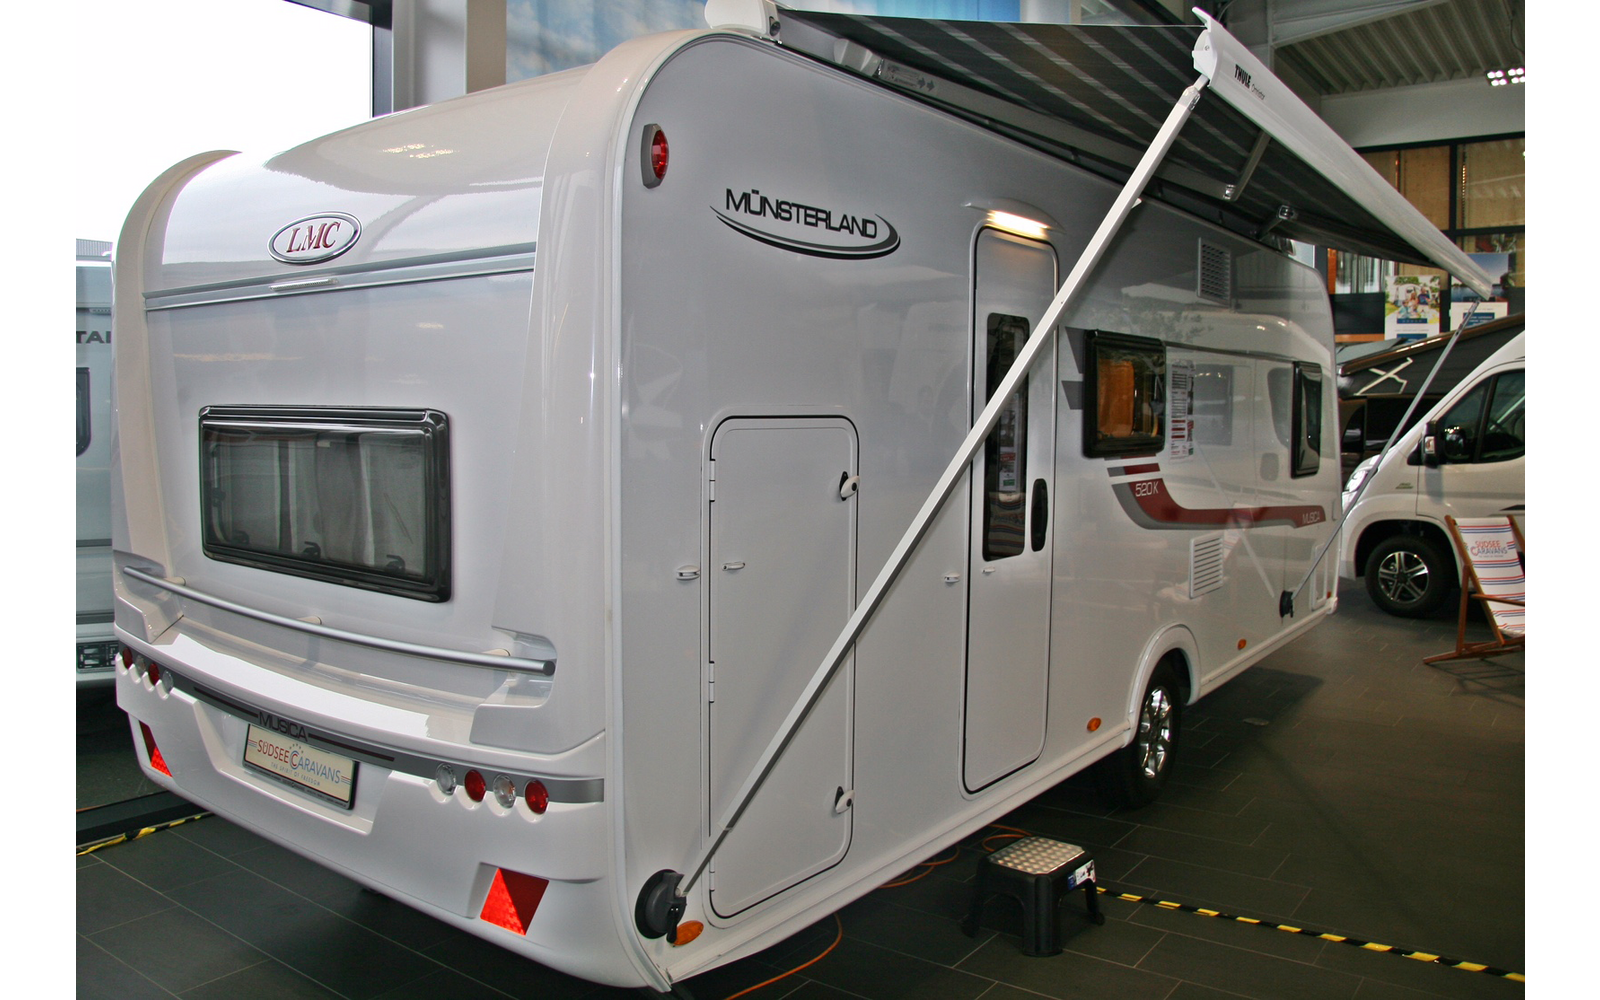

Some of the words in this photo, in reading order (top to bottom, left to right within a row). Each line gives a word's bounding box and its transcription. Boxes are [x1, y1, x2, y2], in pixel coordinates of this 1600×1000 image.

[1234, 63, 1251, 89] THULE
[726, 188, 877, 239] MÜNSTERLAND
[286, 221, 341, 252] LMC
[259, 711, 308, 742] MUSICA
[257, 739, 290, 764] SÜDSEE
[289, 749, 341, 784] CARAVANS
